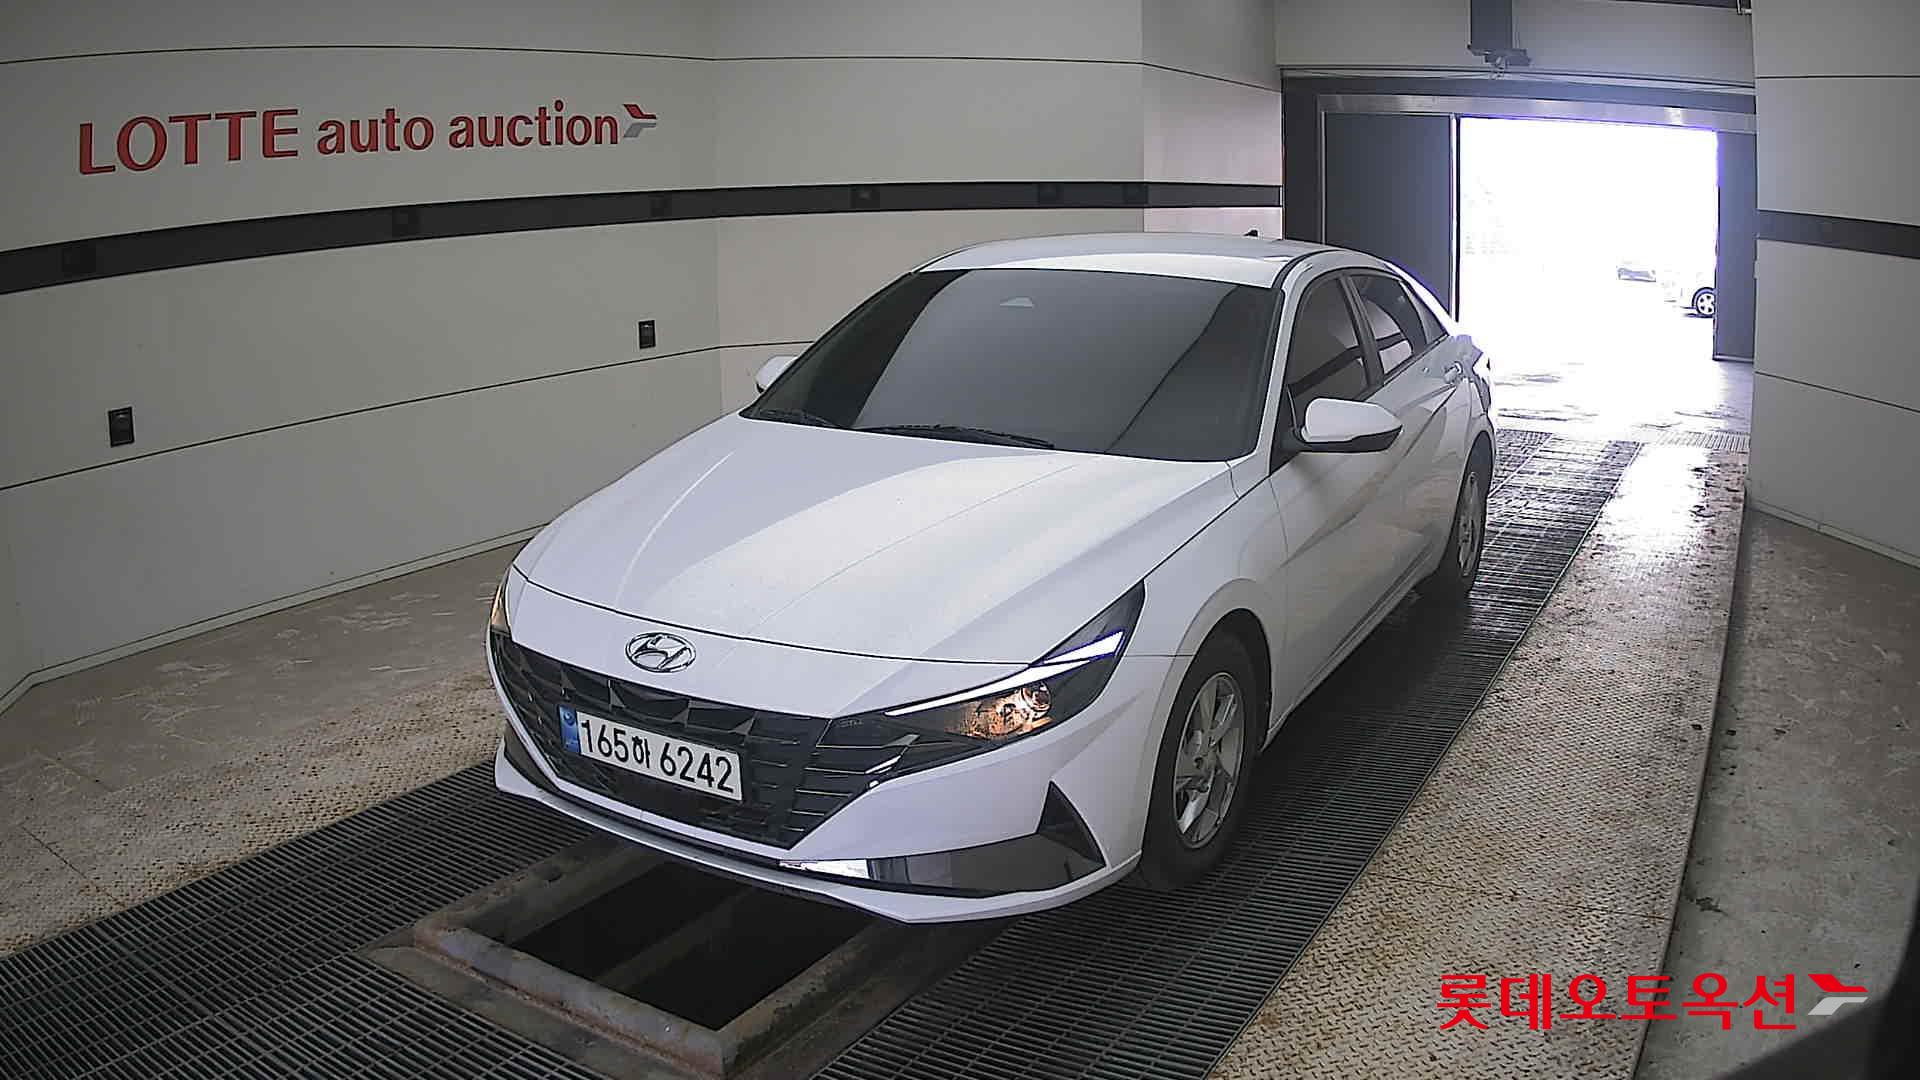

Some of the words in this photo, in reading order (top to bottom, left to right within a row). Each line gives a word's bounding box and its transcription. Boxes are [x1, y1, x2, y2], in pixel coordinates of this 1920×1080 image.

[79, 109, 299, 175] LOTTE
[316, 108, 434, 154] auto
[448, 100, 619, 147] auction
[581, 719, 651, 769] 165하
[659, 742, 734, 793] 6242
